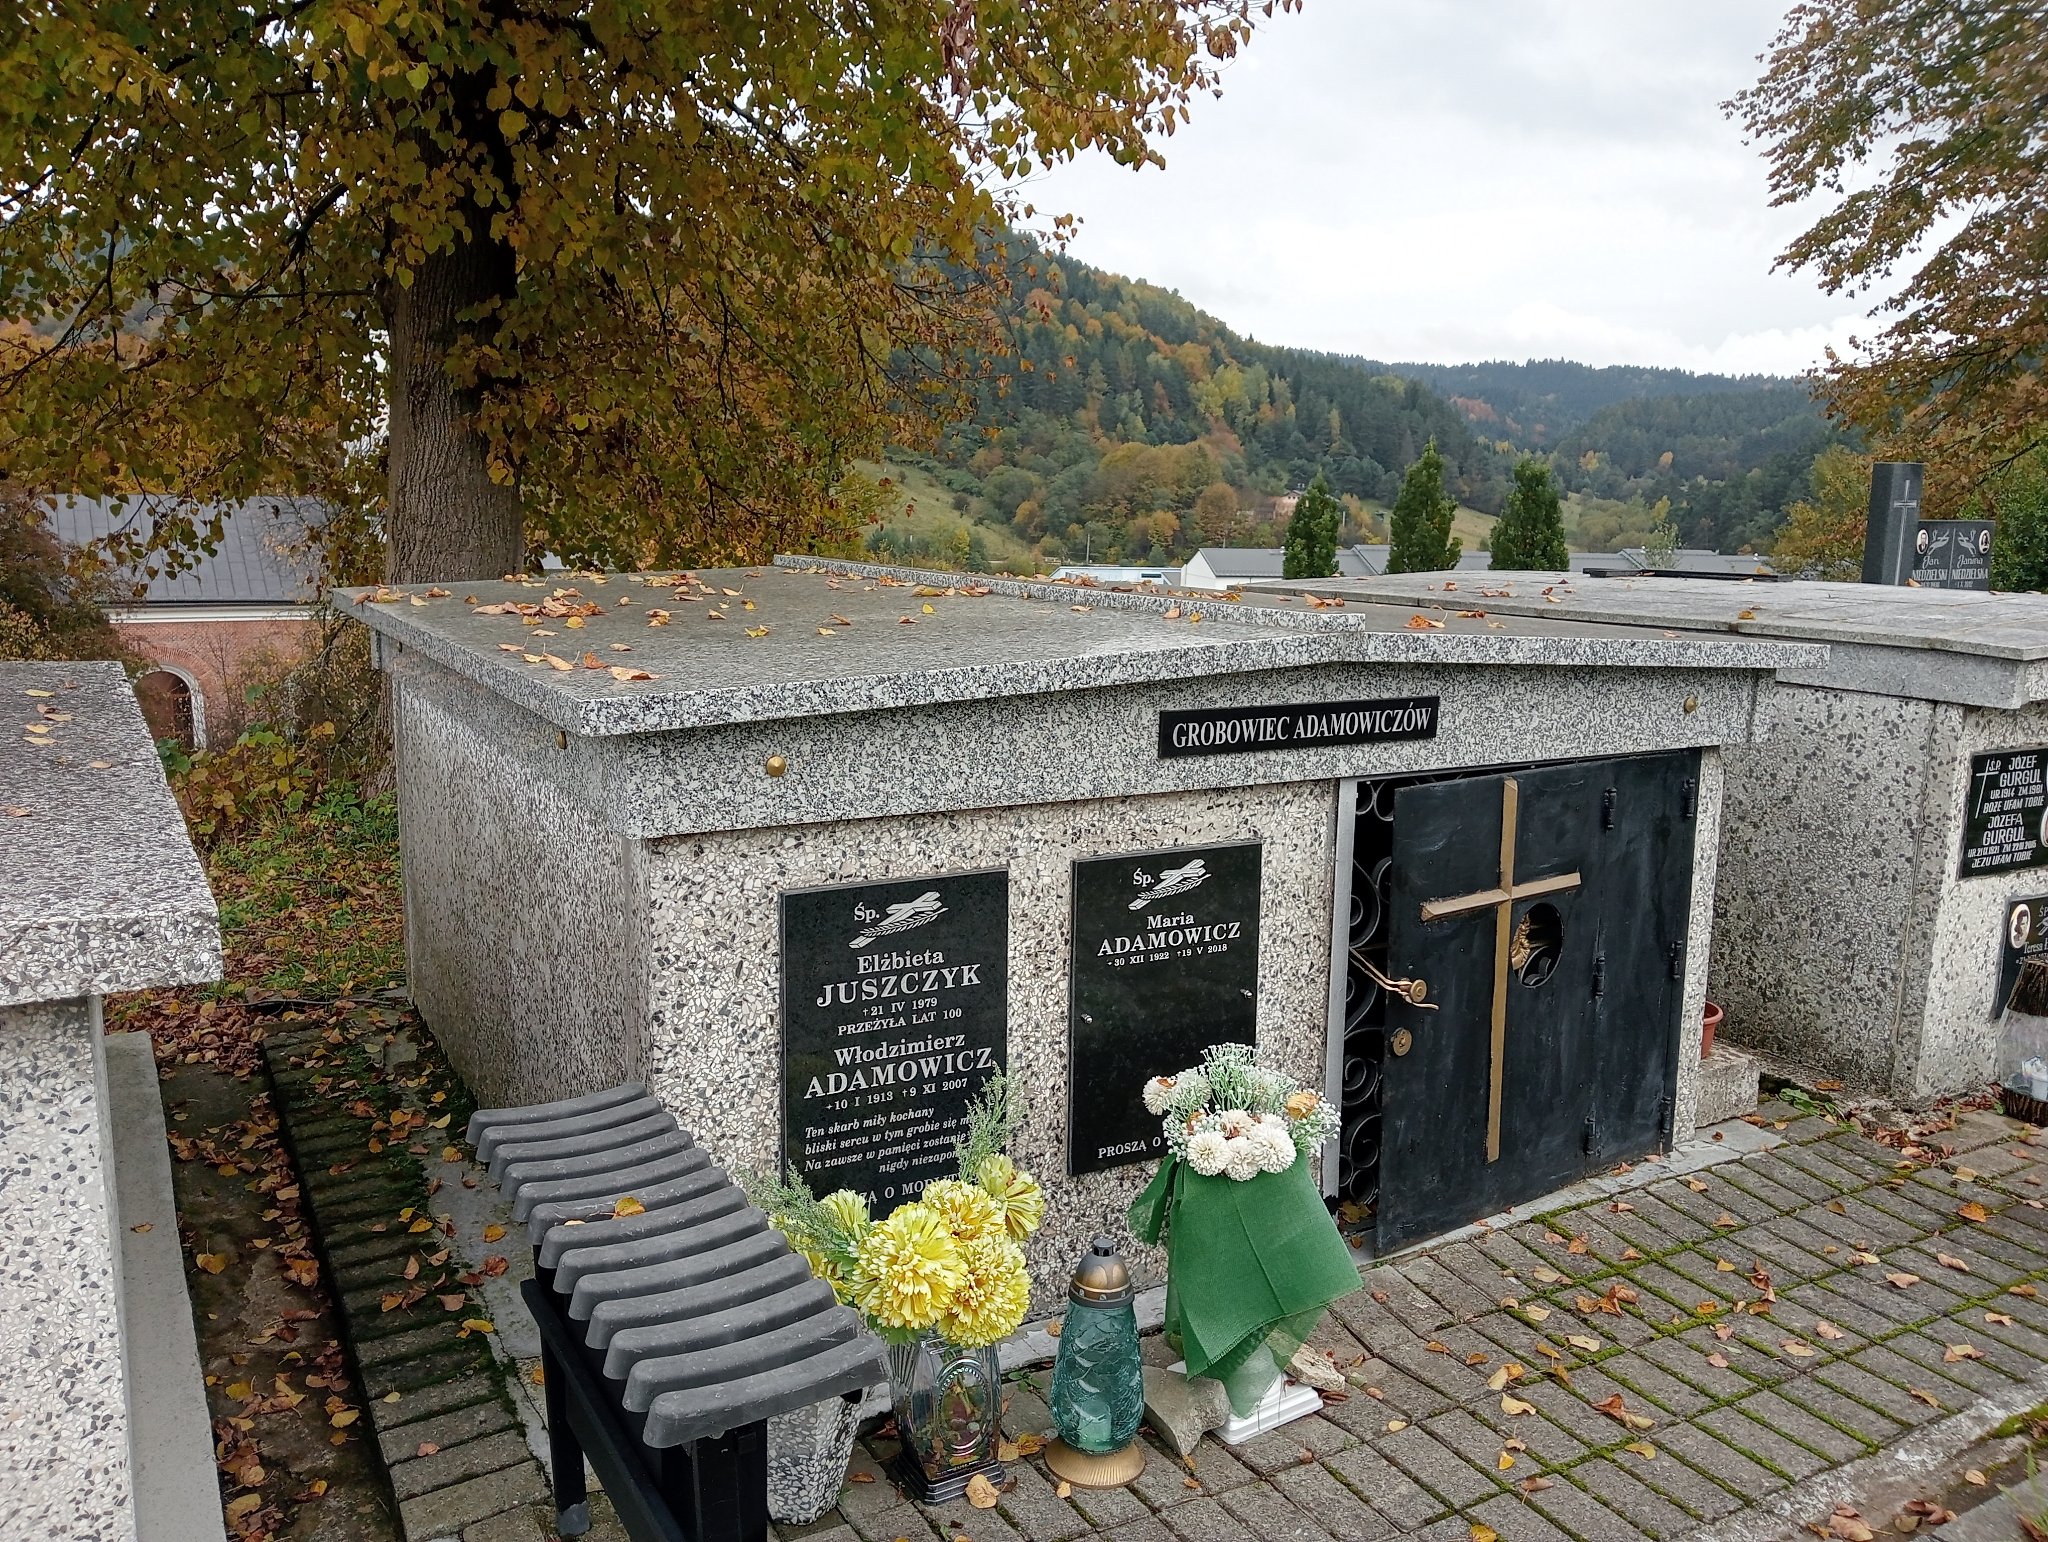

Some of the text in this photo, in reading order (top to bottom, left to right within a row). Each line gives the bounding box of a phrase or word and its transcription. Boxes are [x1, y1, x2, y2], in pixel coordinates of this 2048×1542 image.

[1172, 702, 1432, 748] GROBOWIEC ADAMOWICZÓW
[2008, 754, 2038, 770] JÓZEF
[2000, 769, 2042, 787] GURGUL
[2004, 798, 2023, 810] UFAM
[2024, 796, 2045, 808] TOBIE
[1983, 826, 2025, 846] GURGUL
[2013, 850, 2033, 862] TOBIE
[1133, 868, 1155, 887] Śp.
[854, 902, 880, 922] Śp.
[1146, 912, 1194, 930] Maria
[1097, 922, 1241, 956] ADAMOWICZ
[857, 949, 944, 974] Elżbieta
[1130, 955, 1144, 964] XII
[1149, 952, 1169, 962] 1922
[1197, 947, 1203, 955] V
[1208, 944, 1228, 954] 2018
[816, 963, 981, 1007] JUSZCZYK
[891, 1001, 906, 1013] IV
[912, 997, 938, 1009] 1979
[838, 1008, 962, 1036] PRZEŻYŁA LAT 100
[834, 1034, 965, 1066] Włodzimierz
[803, 1047, 992, 1099] ADAMOWICZ
[854, 1097, 860, 1107] I
[867, 1091, 893, 1105] 1913
[923, 1083, 936, 1094] XI
[942, 1078, 968, 1091] 2007
[805, 1108, 934, 1138] Ten skarb miły kochany
[805, 1139, 837, 1155] bliski
[840, 1136, 869, 1148] sercu
[872, 1133, 882, 1142] w
[885, 1129, 904, 1141] tym
[906, 1120, 940, 1138] grobie
[942, 1117, 957, 1129] się
[804, 1159, 822, 1172] Na
[825, 1152, 863, 1168] zawsze
[866, 1150, 875, 1159] w
[877, 1139, 920, 1160] pamięci
[1098, 1136, 1161, 1158] PROSZĄ O
[879, 1158, 909, 1173] nigdy
[884, 1186, 895, 1198] O
